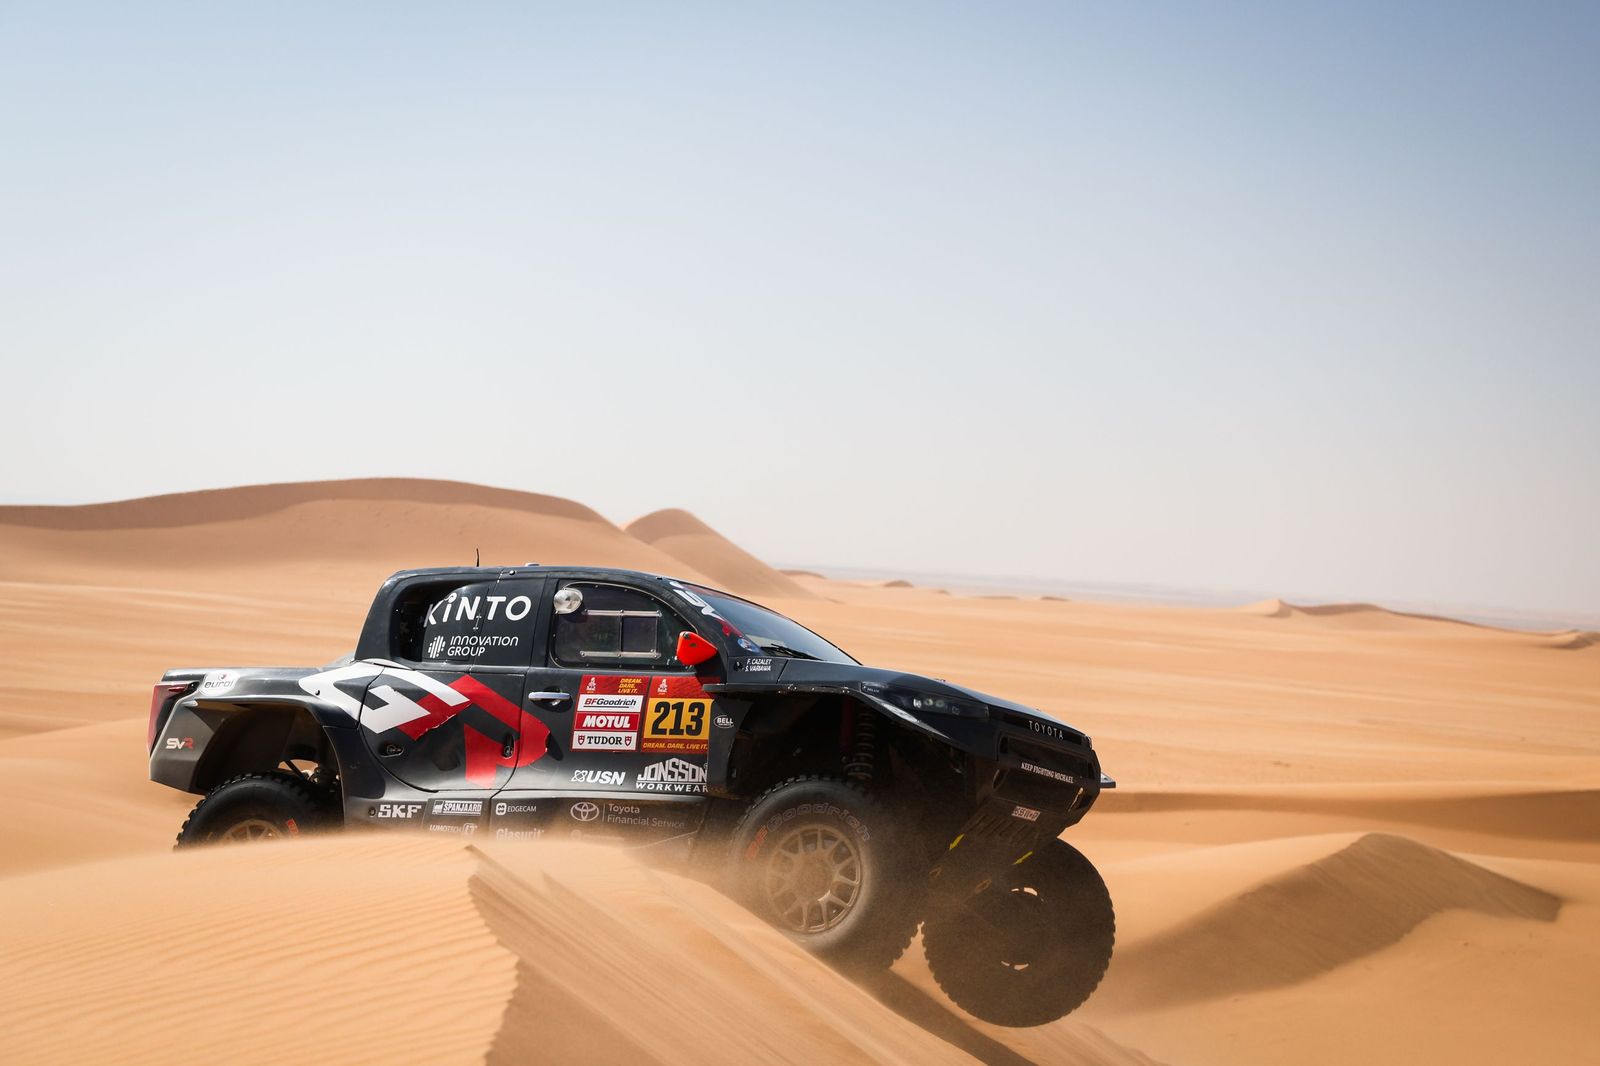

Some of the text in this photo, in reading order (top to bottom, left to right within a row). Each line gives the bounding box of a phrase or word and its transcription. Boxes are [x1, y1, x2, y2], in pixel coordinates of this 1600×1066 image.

[450, 635, 519, 647] INNOVATION
[447, 646, 486, 657] GROUP
[584, 698, 637, 706] BFGoodrich
[582, 715, 631, 729] MOTUL
[651, 701, 706, 737] 213
[1028, 720, 1063, 739] TOYOTA
[587, 736, 622, 745] TUDOR
[637, 757, 707, 781] JONSSON
[1021, 762, 1033, 772] KEEP
[1033, 765, 1054, 779] FIGHTING
[587, 771, 626, 786] USN
[635, 783, 709, 793] WORKWEAR
[378, 804, 422, 819] SKF
[443, 801, 482, 813] SPANJAARD
[507, 805, 537, 813] EDGECAM
[608, 803, 640, 815] Toyota
[607, 815, 649, 825] Financial
